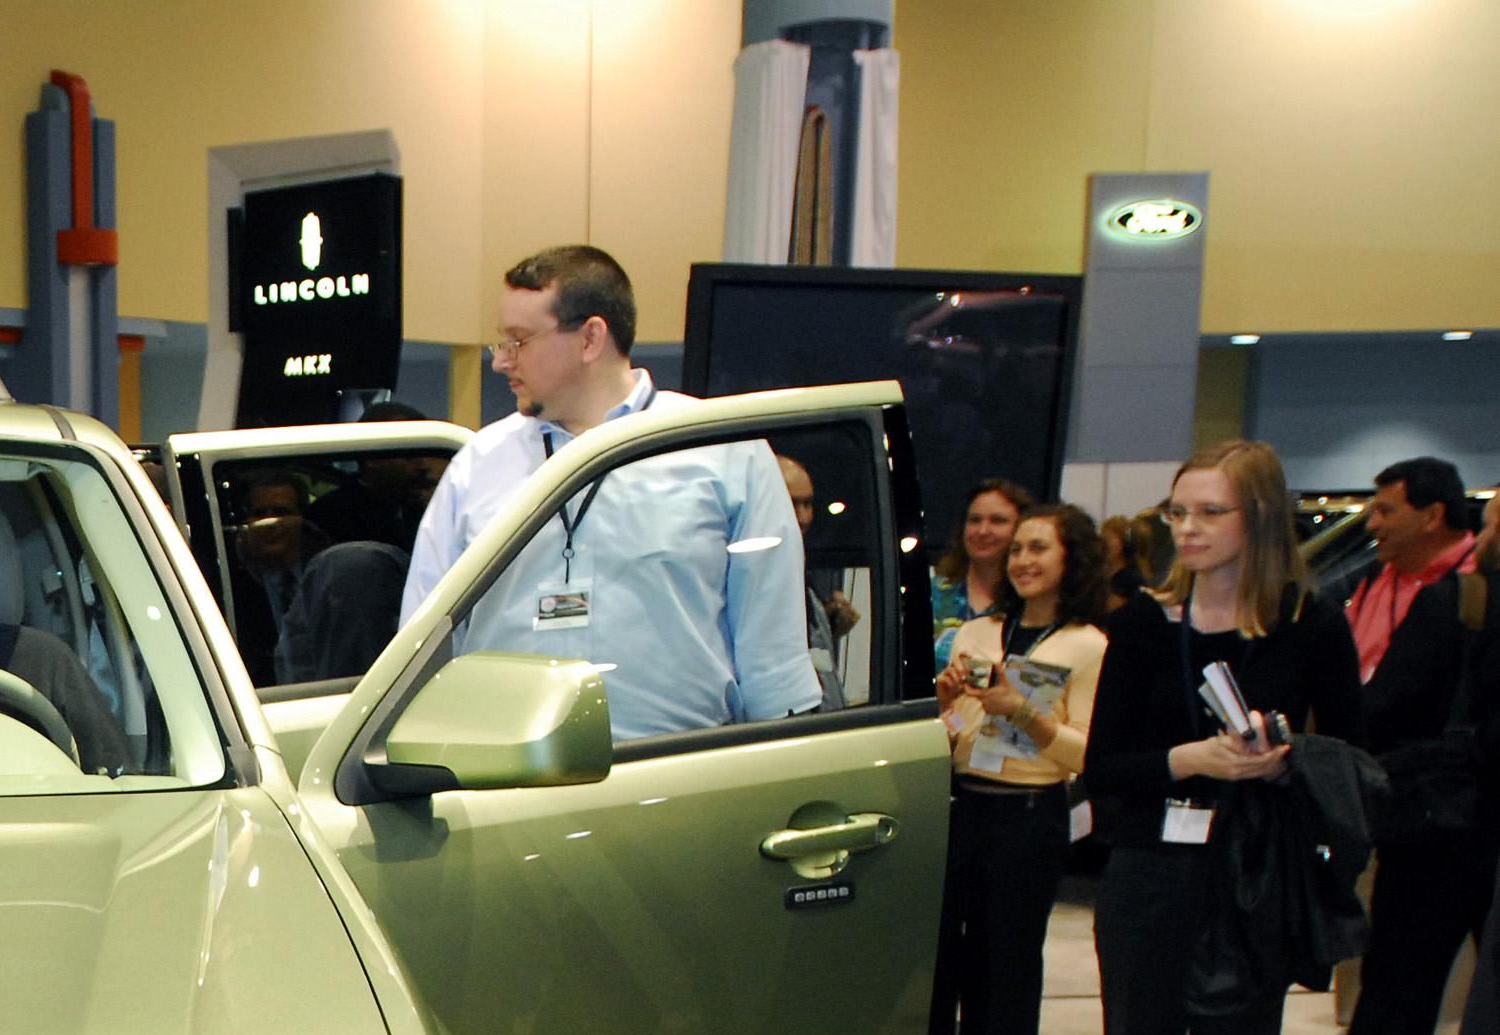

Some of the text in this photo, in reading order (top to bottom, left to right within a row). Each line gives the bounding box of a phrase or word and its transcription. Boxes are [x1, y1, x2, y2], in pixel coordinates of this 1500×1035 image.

[1122, 202, 1192, 236] Ford
[254, 273, 369, 305] LINCOLN
[283, 353, 332, 377] MKX
